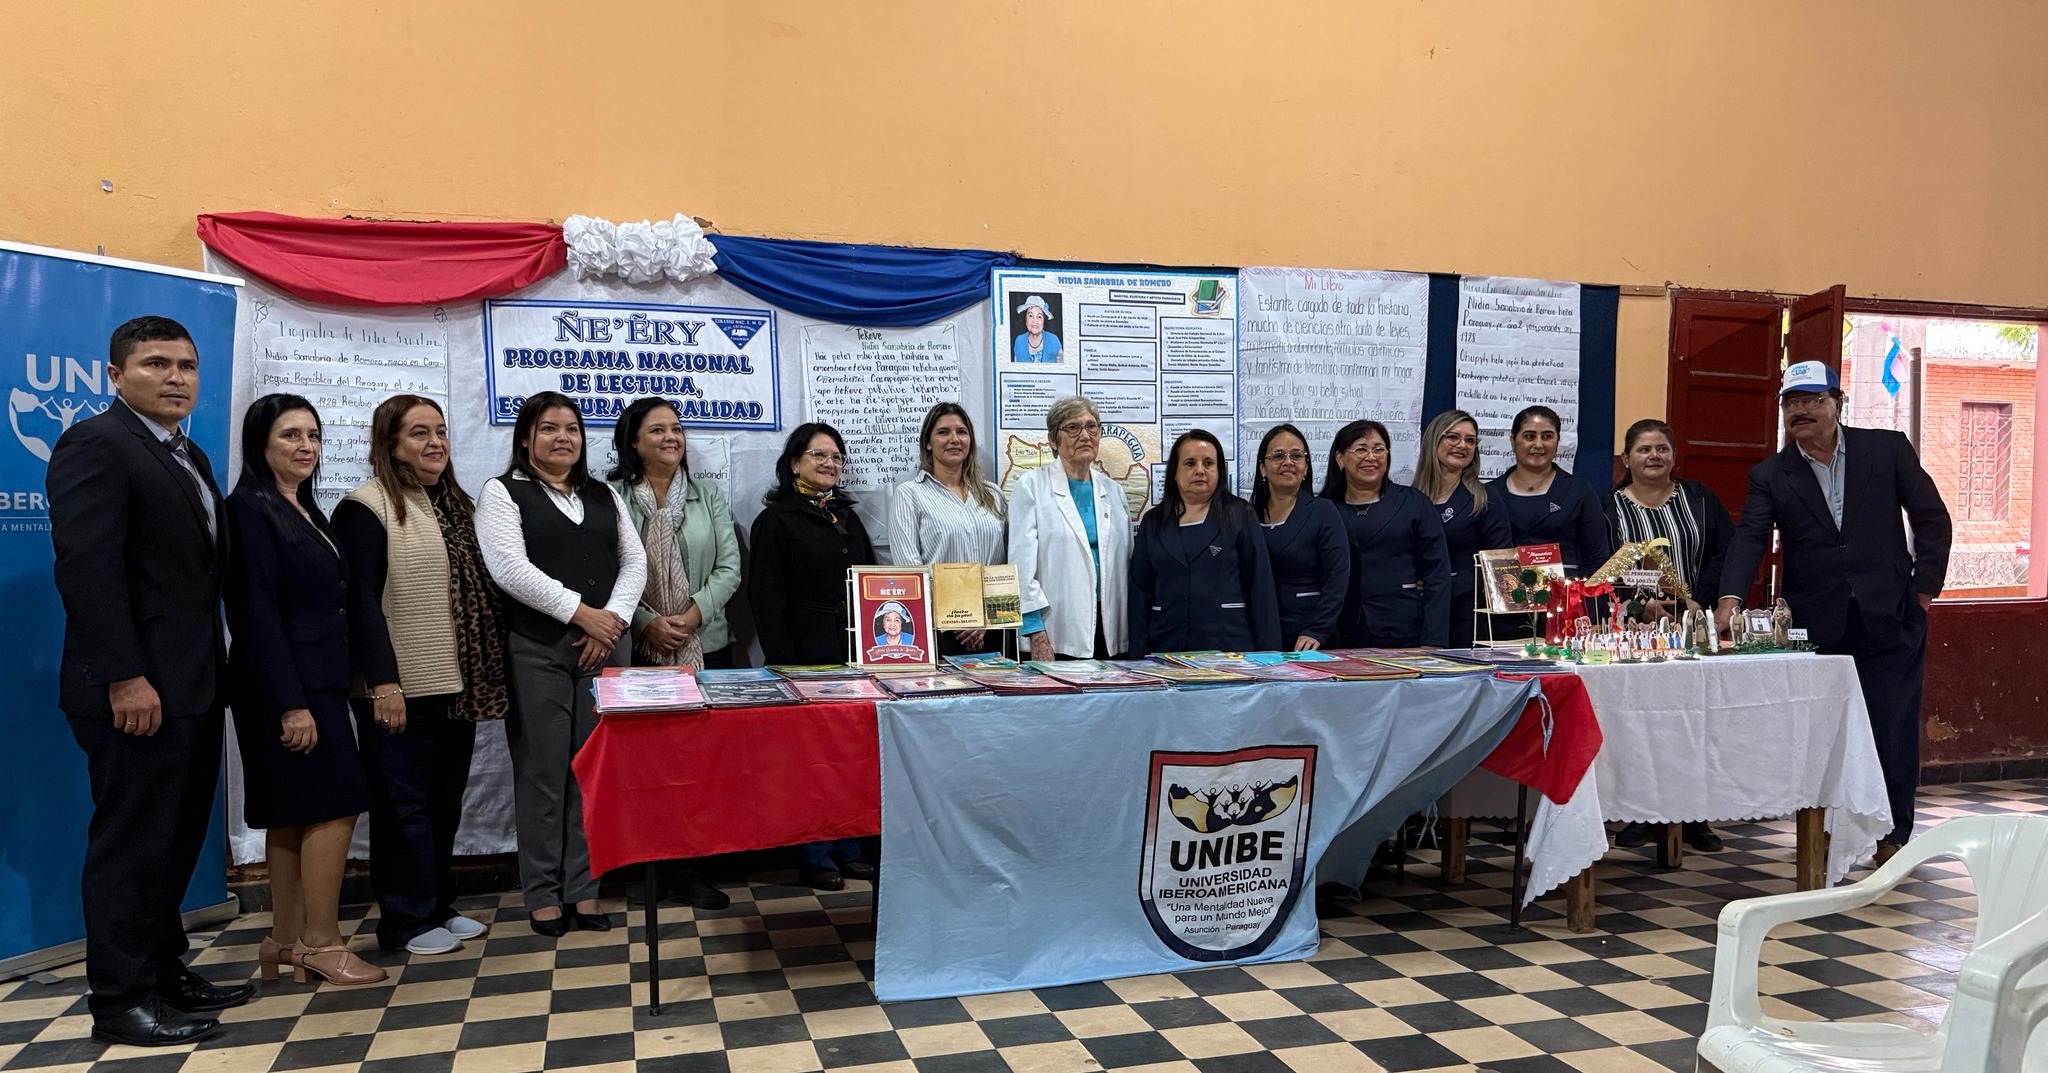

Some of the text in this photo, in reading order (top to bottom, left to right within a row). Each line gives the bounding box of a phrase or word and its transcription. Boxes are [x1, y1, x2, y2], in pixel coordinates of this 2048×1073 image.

[1058, 276, 1082, 284] NIDIA
[1084, 278, 1124, 286] SANABRIA
[1140, 279, 1172, 287] ROMERO
[1304, 276, 1344, 291] Mi Libro
[1258, 294, 1294, 312] Estante
[1298, 294, 1328, 320] cargado
[1332, 298, 1342, 314] de
[1346, 300, 1364, 314] toda
[1368, 298, 1375, 316] la
[1467, 296, 1490, 310] Nidia
[1526, 304, 1533, 314] de
[856, 328, 882, 341] Tekove
[1283, 318, 1294, 334] de
[1376, 323, 1386, 338] de
[862, 342, 880, 350] Nidia
[882, 342, 916, 350] Sanabria
[265, 348, 288, 361] Nidia
[294, 350, 332, 362] Sanabria
[338, 353, 348, 364] de
[504, 348, 754, 374] PROGRAMA NACIONAL
[934, 353, 944, 361] ha
[1293, 360, 1302, 375] de
[294, 373, 332, 386] República
[337, 374, 350, 386] del
[356, 377, 388, 392] Paraguay
[394, 378, 402, 388] el
[408, 382, 414, 390] 2
[419, 382, 428, 392] de
[560, 374, 703, 398] DE LECTURA,
[924, 374, 935, 382] ha
[1247, 384, 1262, 398] que
[1264, 382, 1274, 396] da
[1278, 382, 1286, 397] al
[1308, 386, 1318, 397] su
[316, 396, 336, 407] 1928
[677, 400, 764, 420] RALIDAD
[864, 406, 892, 418] Colegio
[1269, 406, 1291, 422] estoy
[340, 416, 346, 425] lo
[351, 417, 369, 429] largo
[875, 416, 922, 424] Universidad
[1100, 424, 1146, 461] ARAPEGUA
[1170, 831, 1285, 872] UNIBE
[1179, 867, 1272, 888] UNIVERSIDAD
[1158, 878, 1288, 899] IBEROAMERICANA
[1194, 900, 1244, 912] Mentalidad
[1247, 896, 1274, 906] Nueva
[1174, 914, 1198, 924] para
[1200, 913, 1213, 922] un
[1216, 910, 1246, 921] Mundo
[1184, 925, 1220, 934] Asunción
[1226, 922, 1261, 932] Paraguay
